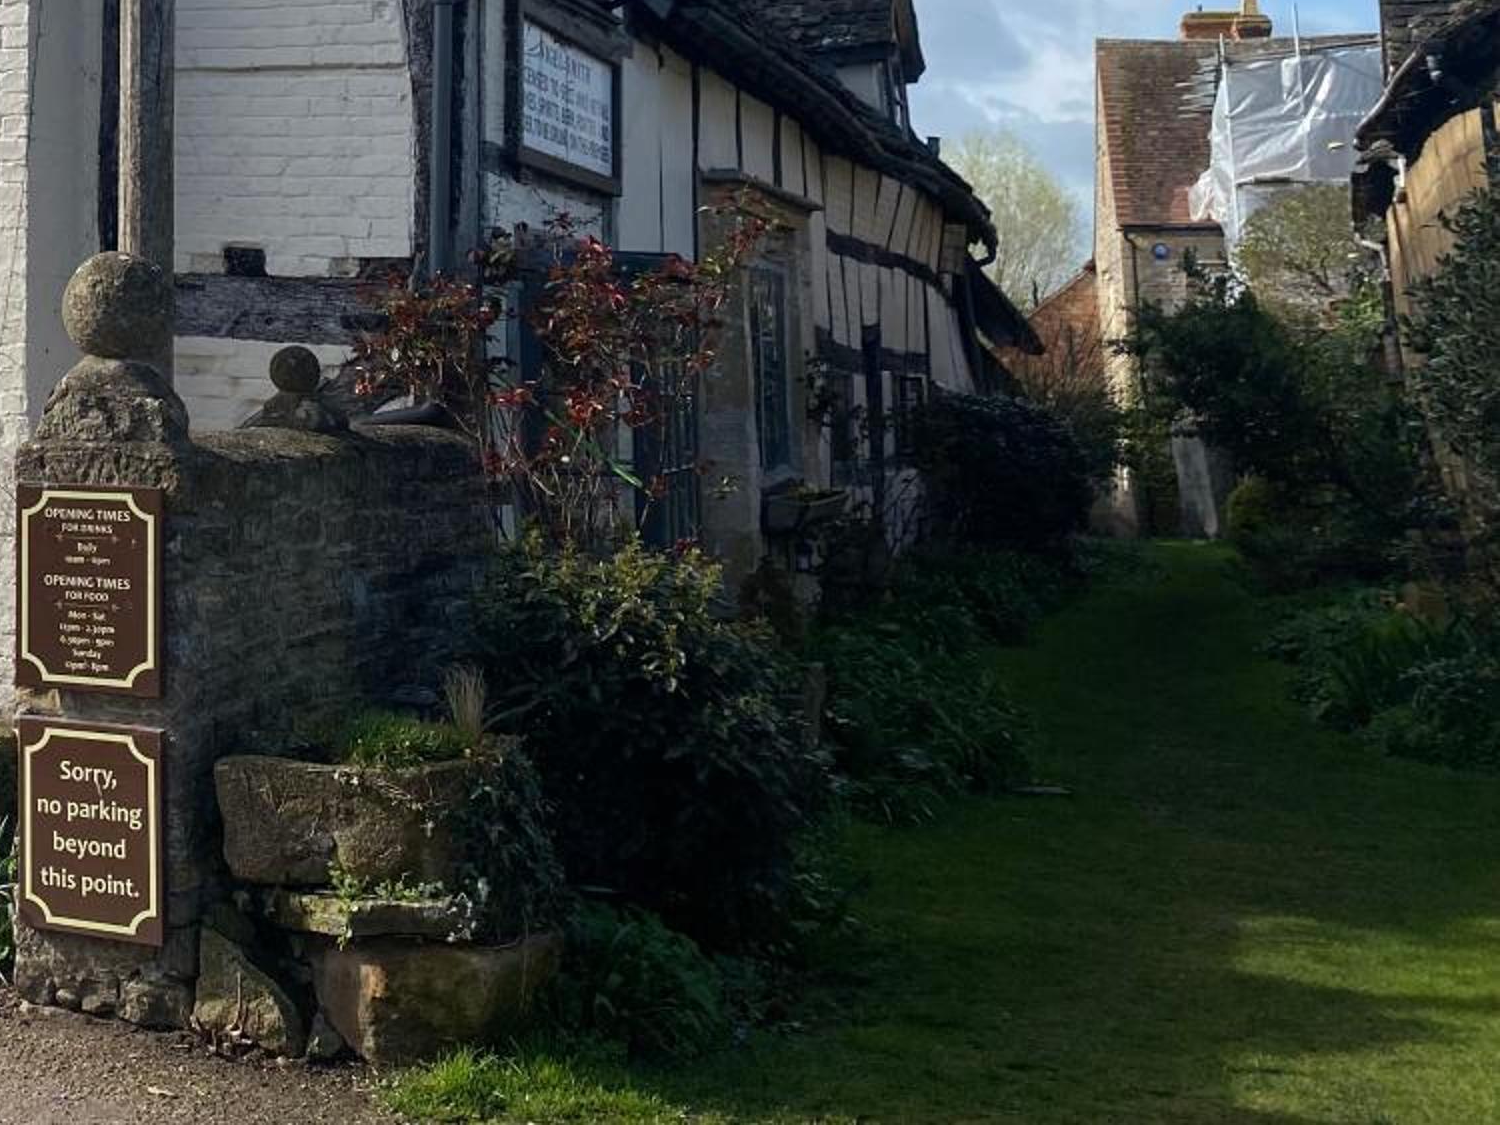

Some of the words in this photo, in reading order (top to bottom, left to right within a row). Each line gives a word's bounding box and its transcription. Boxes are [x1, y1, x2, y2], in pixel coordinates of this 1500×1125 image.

[44, 507, 95, 521] OPENING
[96, 509, 131, 522] TIMES
[62, 523, 79, 532] FOR
[44, 574, 95, 588] OPENING
[96, 577, 131, 590] TIMES
[65, 590, 83, 600] FOR
[84, 592, 109, 602] FOOD
[60, 761, 117, 790] Sorry,
[37, 798, 62, 815] no
[67, 800, 143, 830] parking
[52, 830, 126, 860] beyond
[40, 866, 77, 890] this
[81, 874, 140, 898] point.
